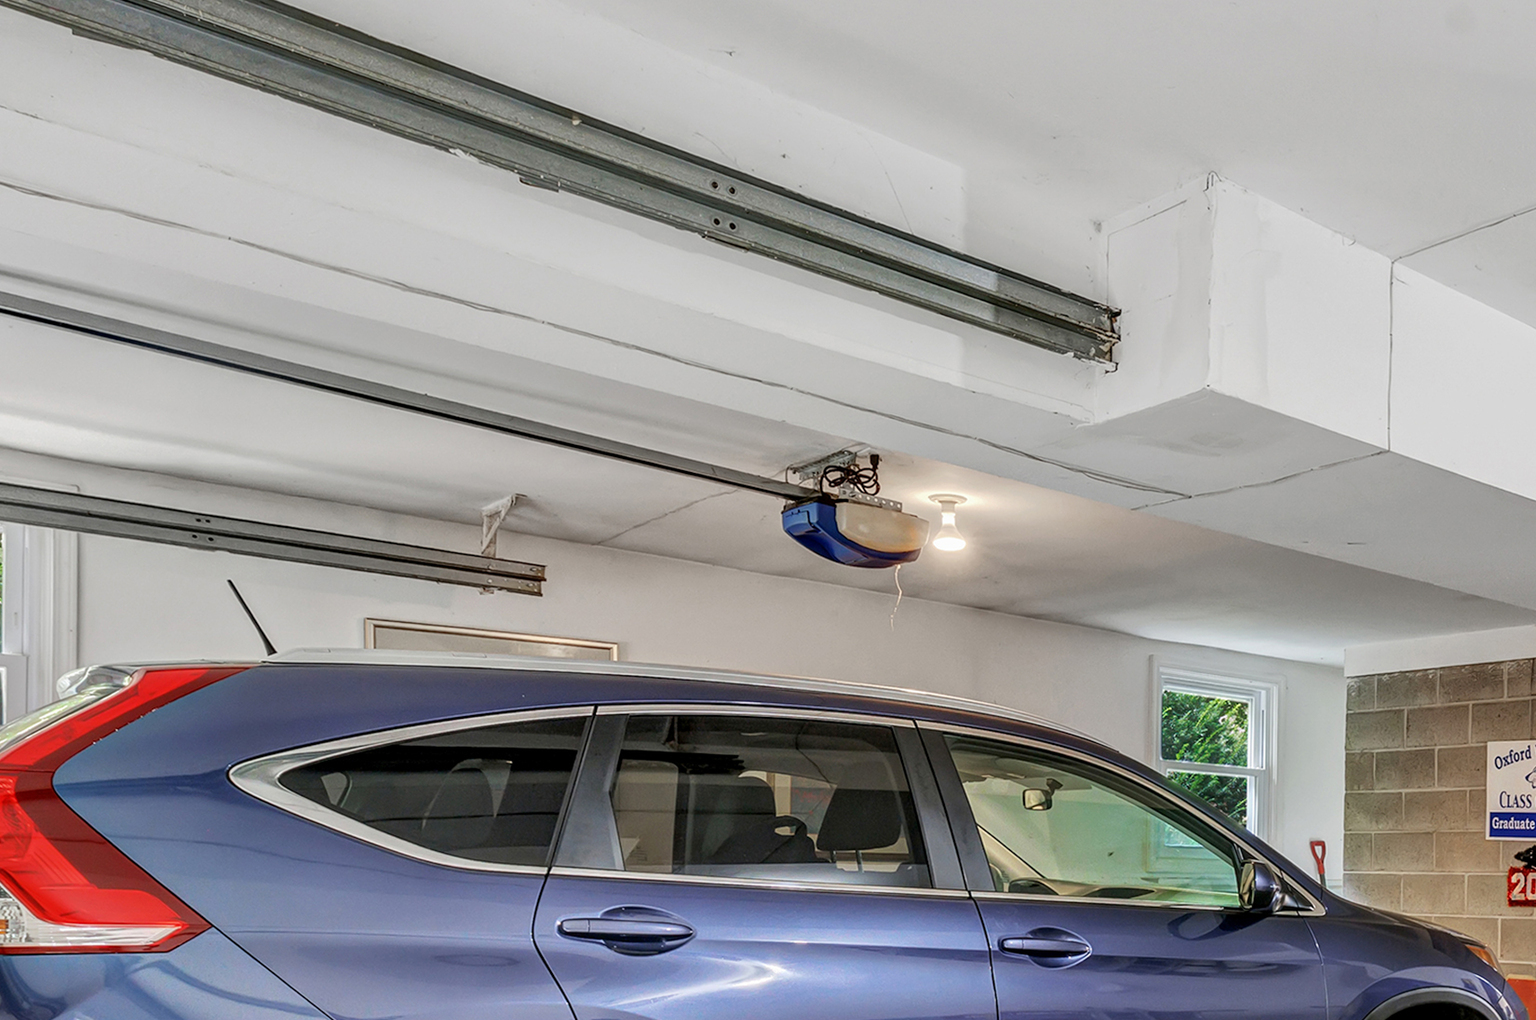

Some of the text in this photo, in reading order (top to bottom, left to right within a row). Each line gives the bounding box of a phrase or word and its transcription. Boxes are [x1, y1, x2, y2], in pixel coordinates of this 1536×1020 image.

[1494, 745, 1532, 770] Oxford
[1499, 791, 1532, 808] CLASS
[1492, 817, 1535, 830] Graduate
